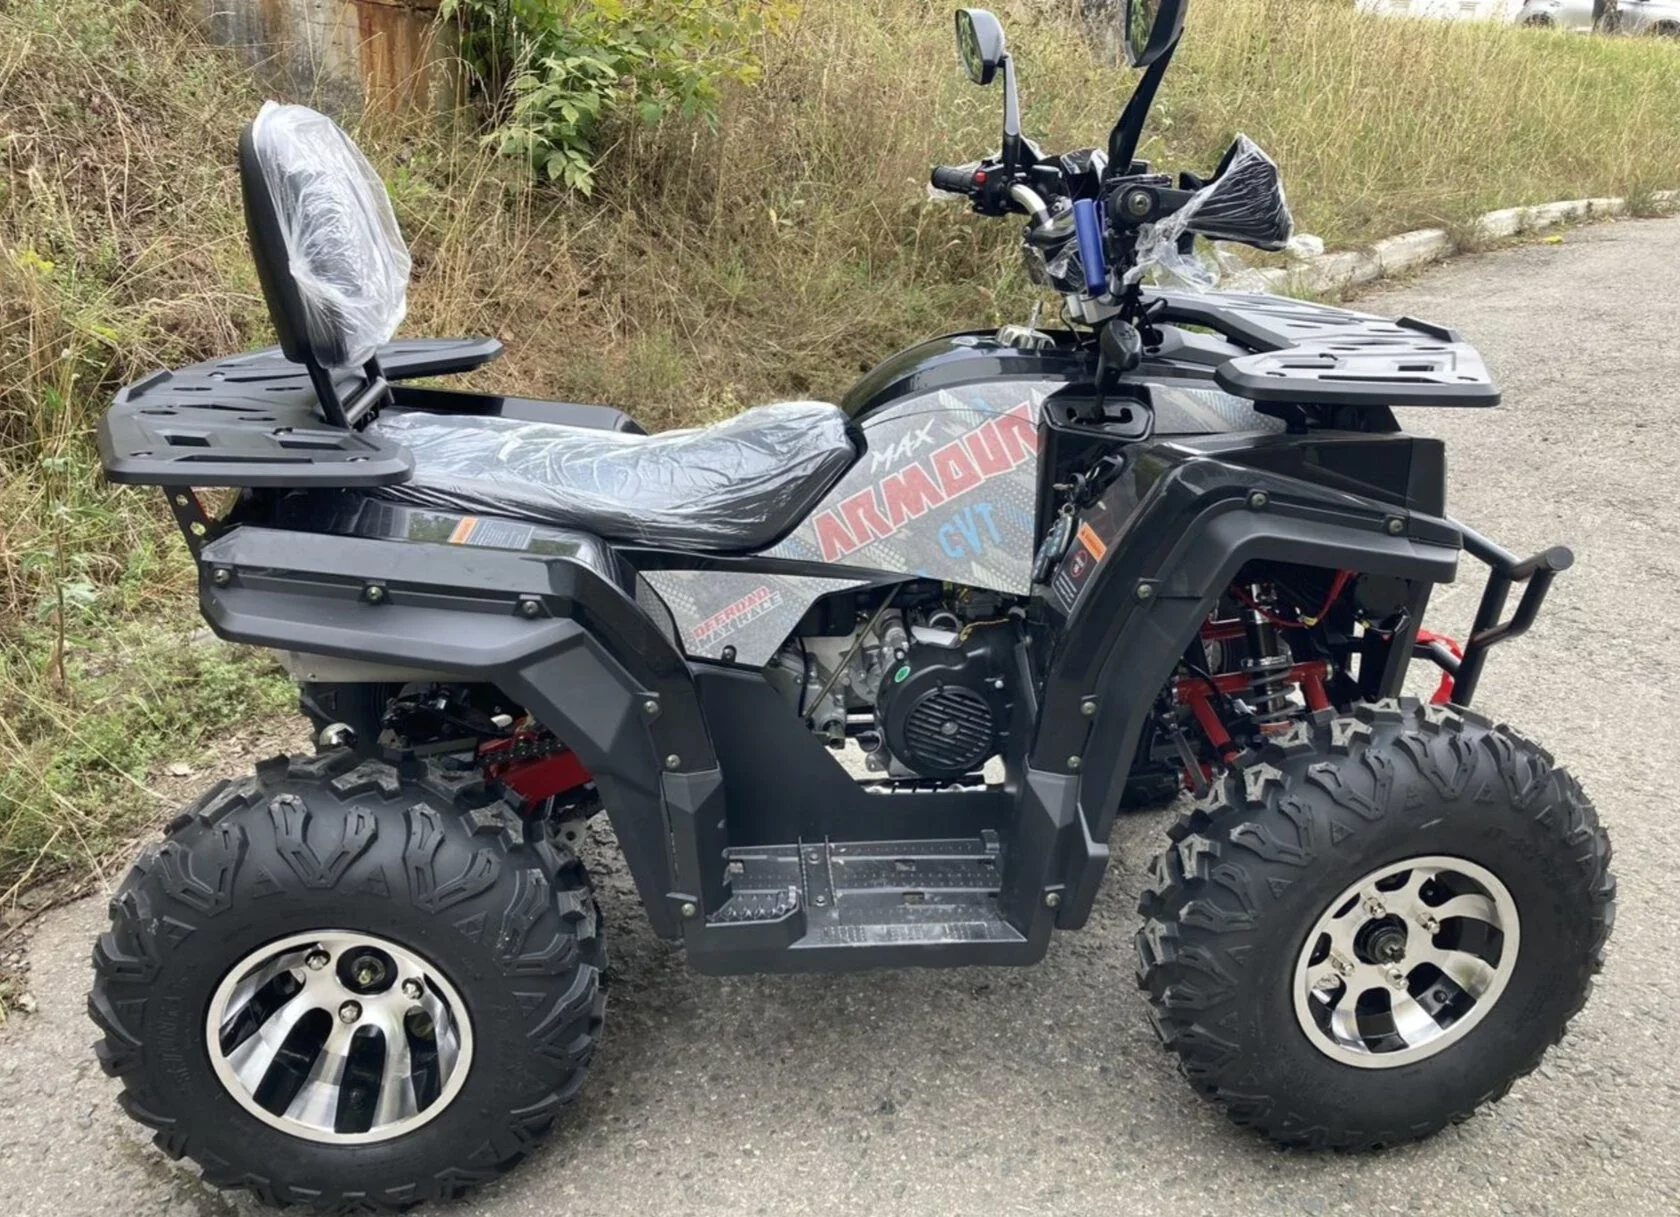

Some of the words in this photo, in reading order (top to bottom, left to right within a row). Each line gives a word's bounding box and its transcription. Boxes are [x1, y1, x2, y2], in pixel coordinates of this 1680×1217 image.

[870, 417, 935, 474] MAX
[812, 400, 1038, 563] ARMOUR
[938, 502, 1004, 558] CVT
[691, 586, 771, 640] OFFROAD
[696, 620, 735, 651] MAX
[735, 591, 784, 628] RACE
